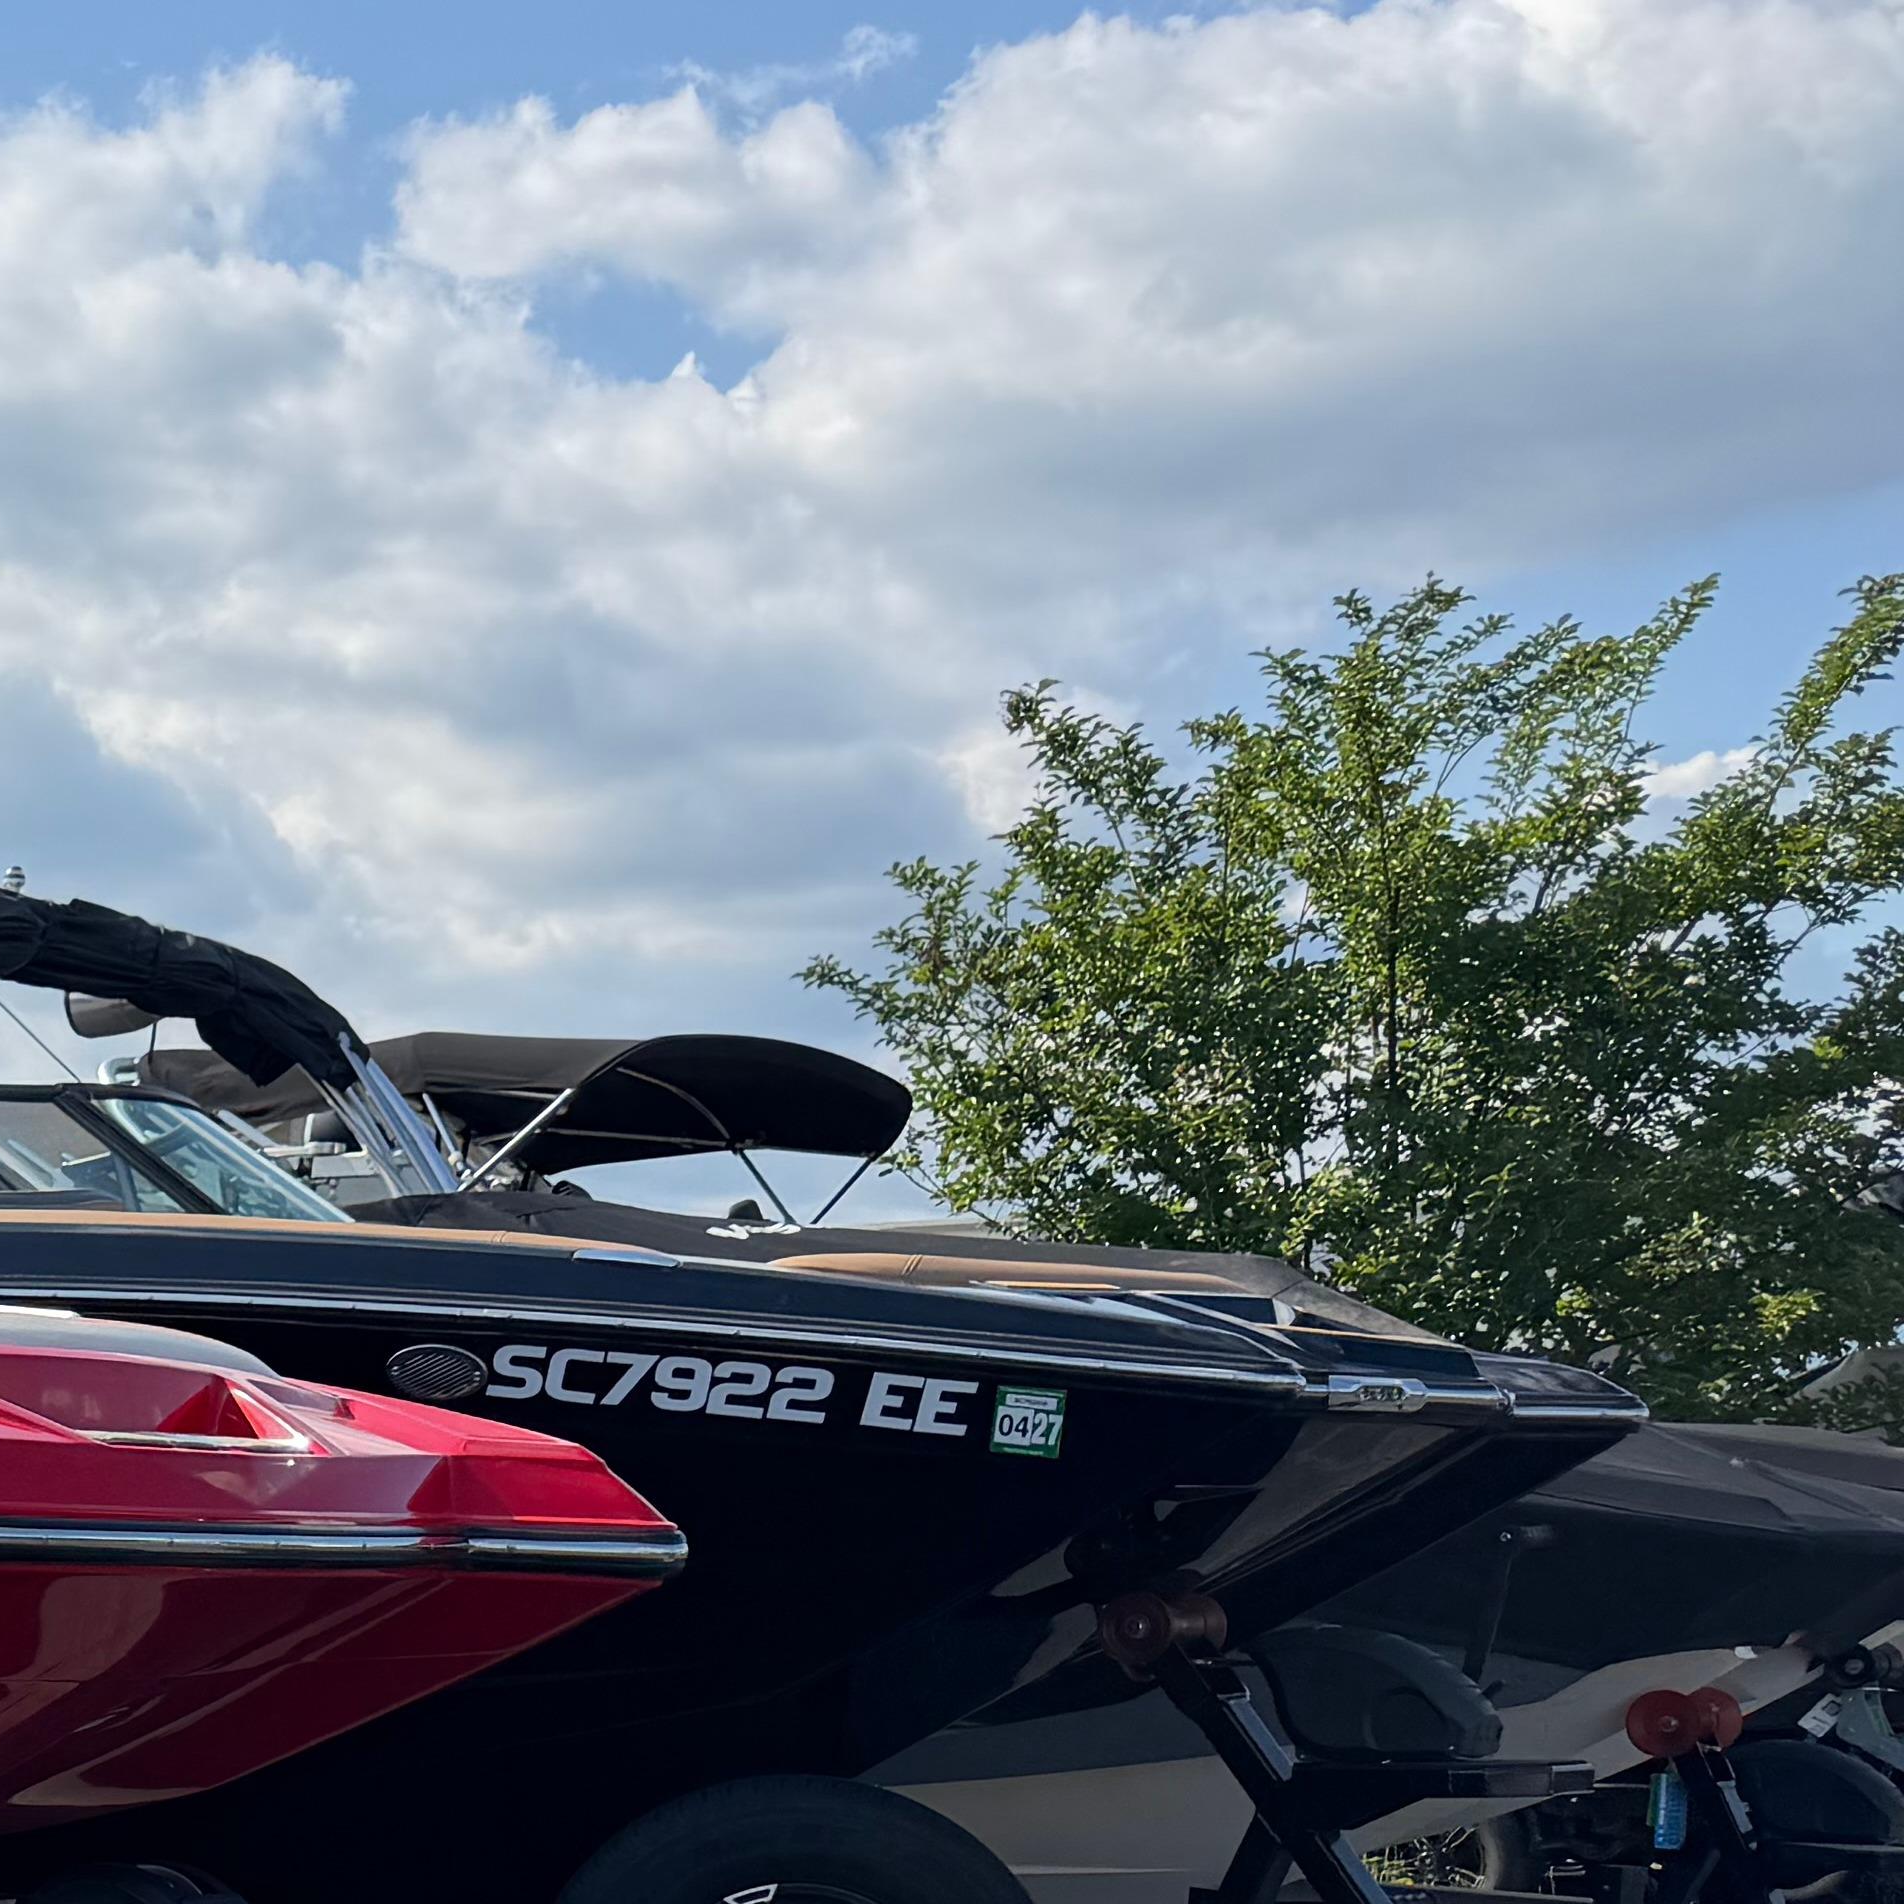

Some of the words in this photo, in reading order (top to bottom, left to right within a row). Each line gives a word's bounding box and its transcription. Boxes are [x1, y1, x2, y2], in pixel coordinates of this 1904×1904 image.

[485, 1344, 835, 1424] SC7922
[859, 1371, 980, 1437] EE
[998, 1413, 1030, 1439] 04
[1031, 1411, 1064, 1446] 27
